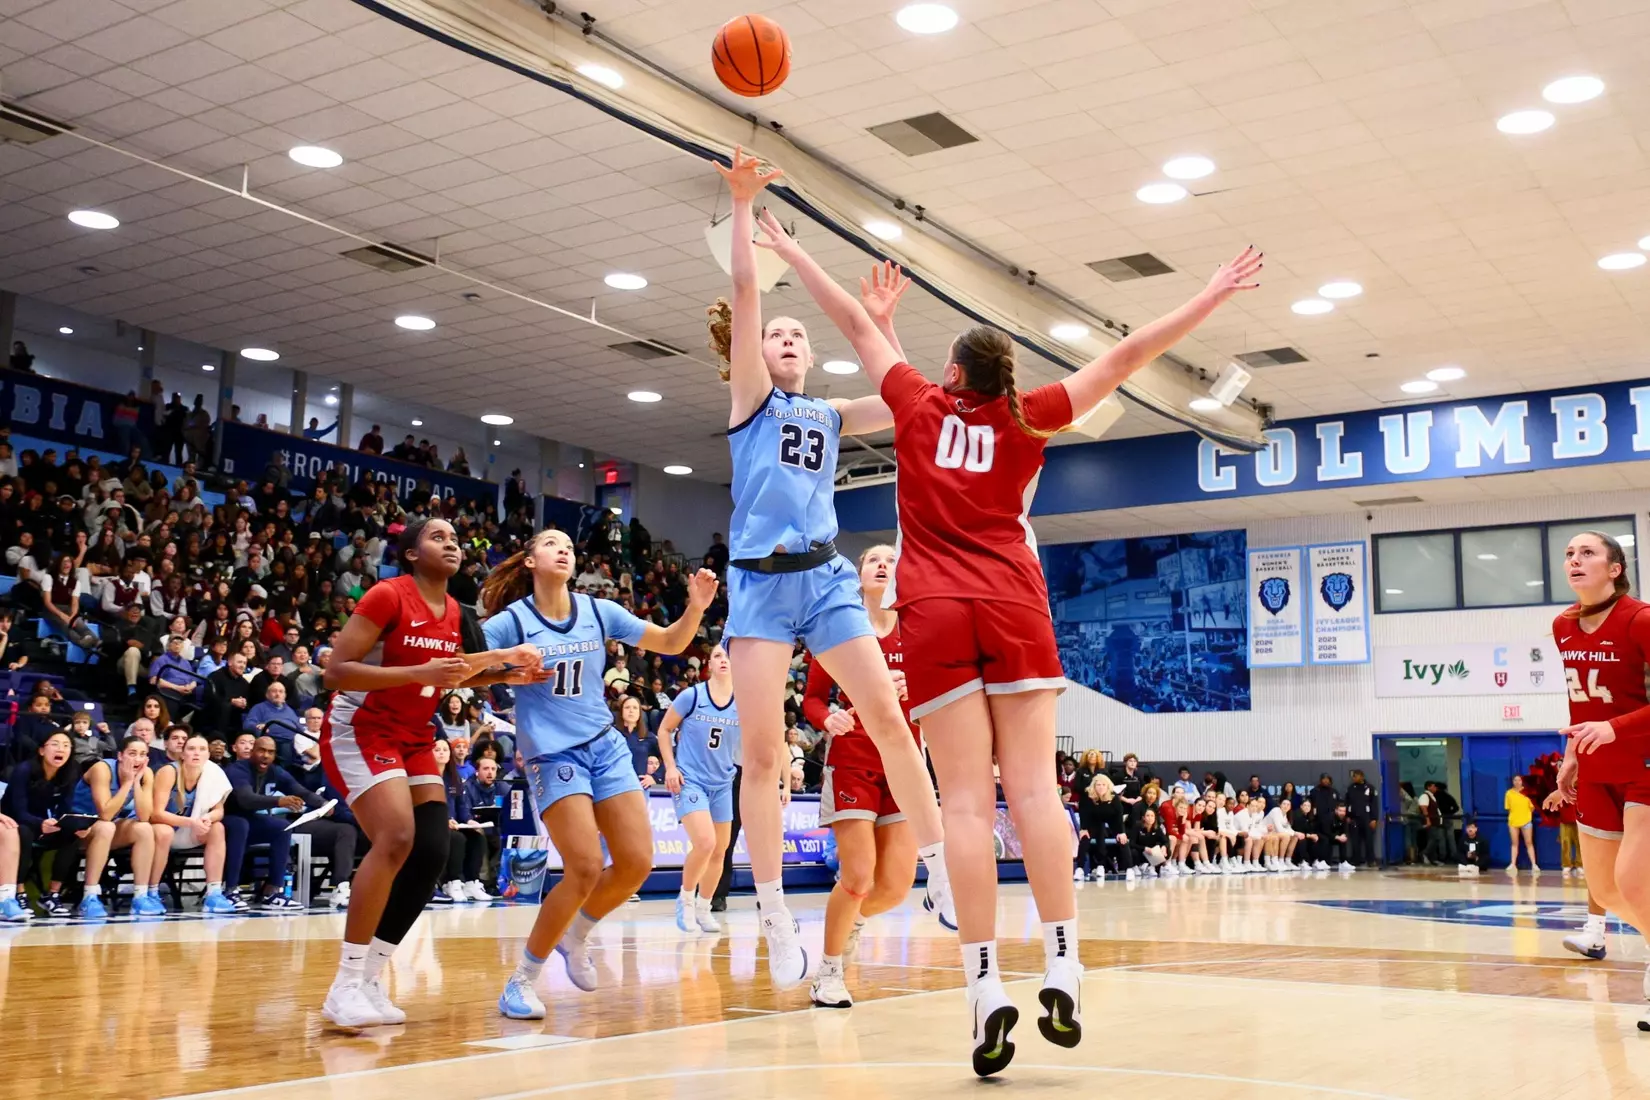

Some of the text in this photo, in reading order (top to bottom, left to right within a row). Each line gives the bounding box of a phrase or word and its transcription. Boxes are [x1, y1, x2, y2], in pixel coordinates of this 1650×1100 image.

[0, 381, 104, 439] BIA
[780, 422, 826, 473] 23
[935, 414, 994, 472] 00
[403, 635, 458, 652] HAWK HI
[539, 640, 600, 657] OLUMBIA
[1493, 647, 1508, 666] C
[1561, 651, 1620, 662] AWK HILL
[552, 659, 584, 697] 11
[1403, 659, 1445, 685] Ivy
[1565, 667, 1613, 703] 24
[1504, 705, 1521, 718] EXIT
[708, 726, 723, 750] 5
[657, 840, 684, 854] BAR
[799, 839, 820, 853] 1207
